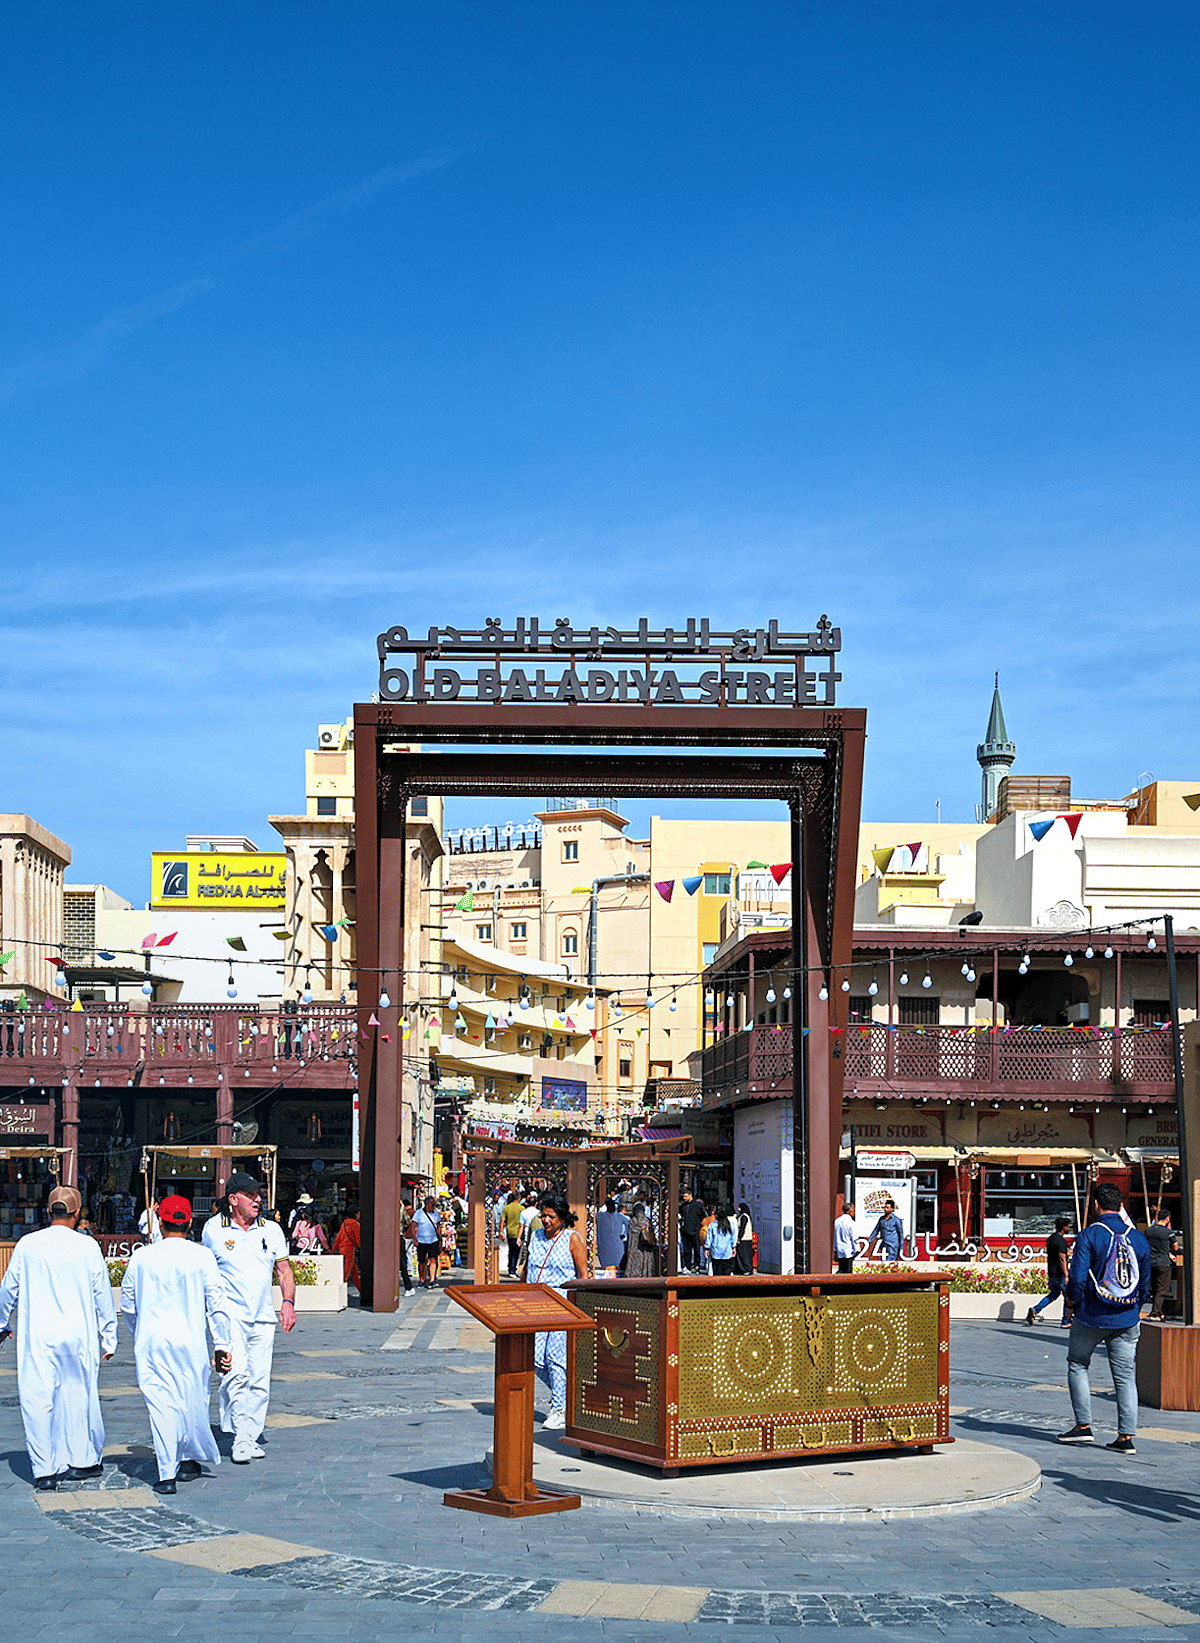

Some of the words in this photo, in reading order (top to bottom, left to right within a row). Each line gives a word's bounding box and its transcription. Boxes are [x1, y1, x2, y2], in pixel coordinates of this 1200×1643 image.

[377, 616, 539, 661] القديم
[552, 617, 710, 661] البلدية
[732, 614, 842, 661] شارع
[379, 667, 461, 701] OLD
[477, 668, 685, 703] BALADIYA
[699, 670, 842, 706] STREET
[197, 862, 275, 881] للصرافة
[197, 884, 244, 899] REDHA
[842, 1124, 882, 1138] TIFI
[886, 1124, 928, 1138] STORE
[298, 1237, 323, 1256] 24
[854, 1238, 889, 1262] 24
[899, 1230, 992, 1262] رمضان
